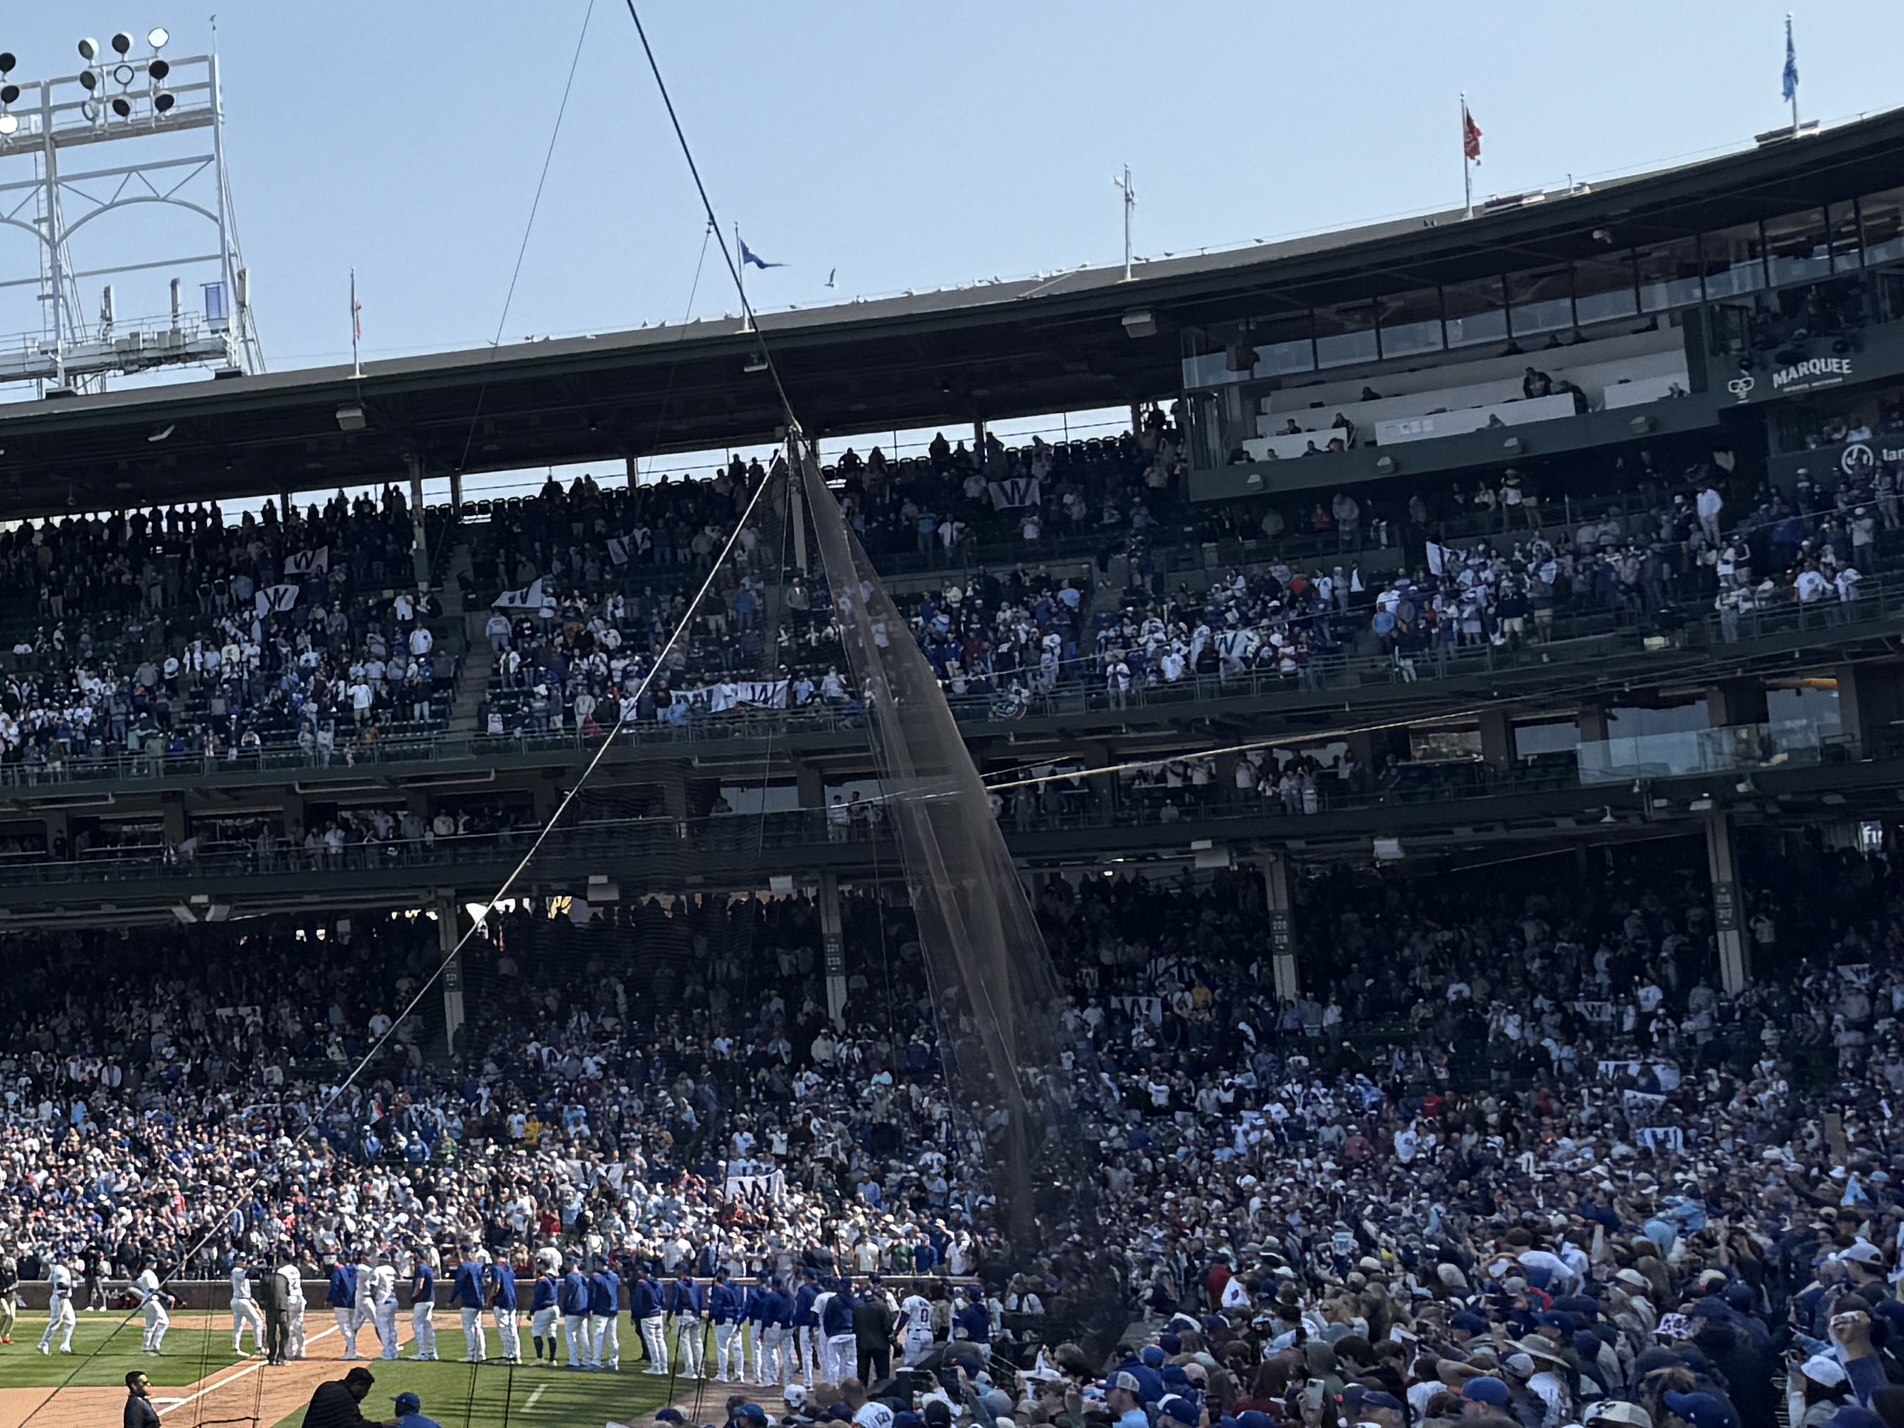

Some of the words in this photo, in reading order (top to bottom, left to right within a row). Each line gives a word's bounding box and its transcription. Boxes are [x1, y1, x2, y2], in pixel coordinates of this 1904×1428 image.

[1772, 358, 1852, 389] MARQUEE
[996, 478, 1032, 505] W
[293, 551, 315, 570] W
[264, 588, 289, 608] W
[920, 1308, 929, 1323] 0
